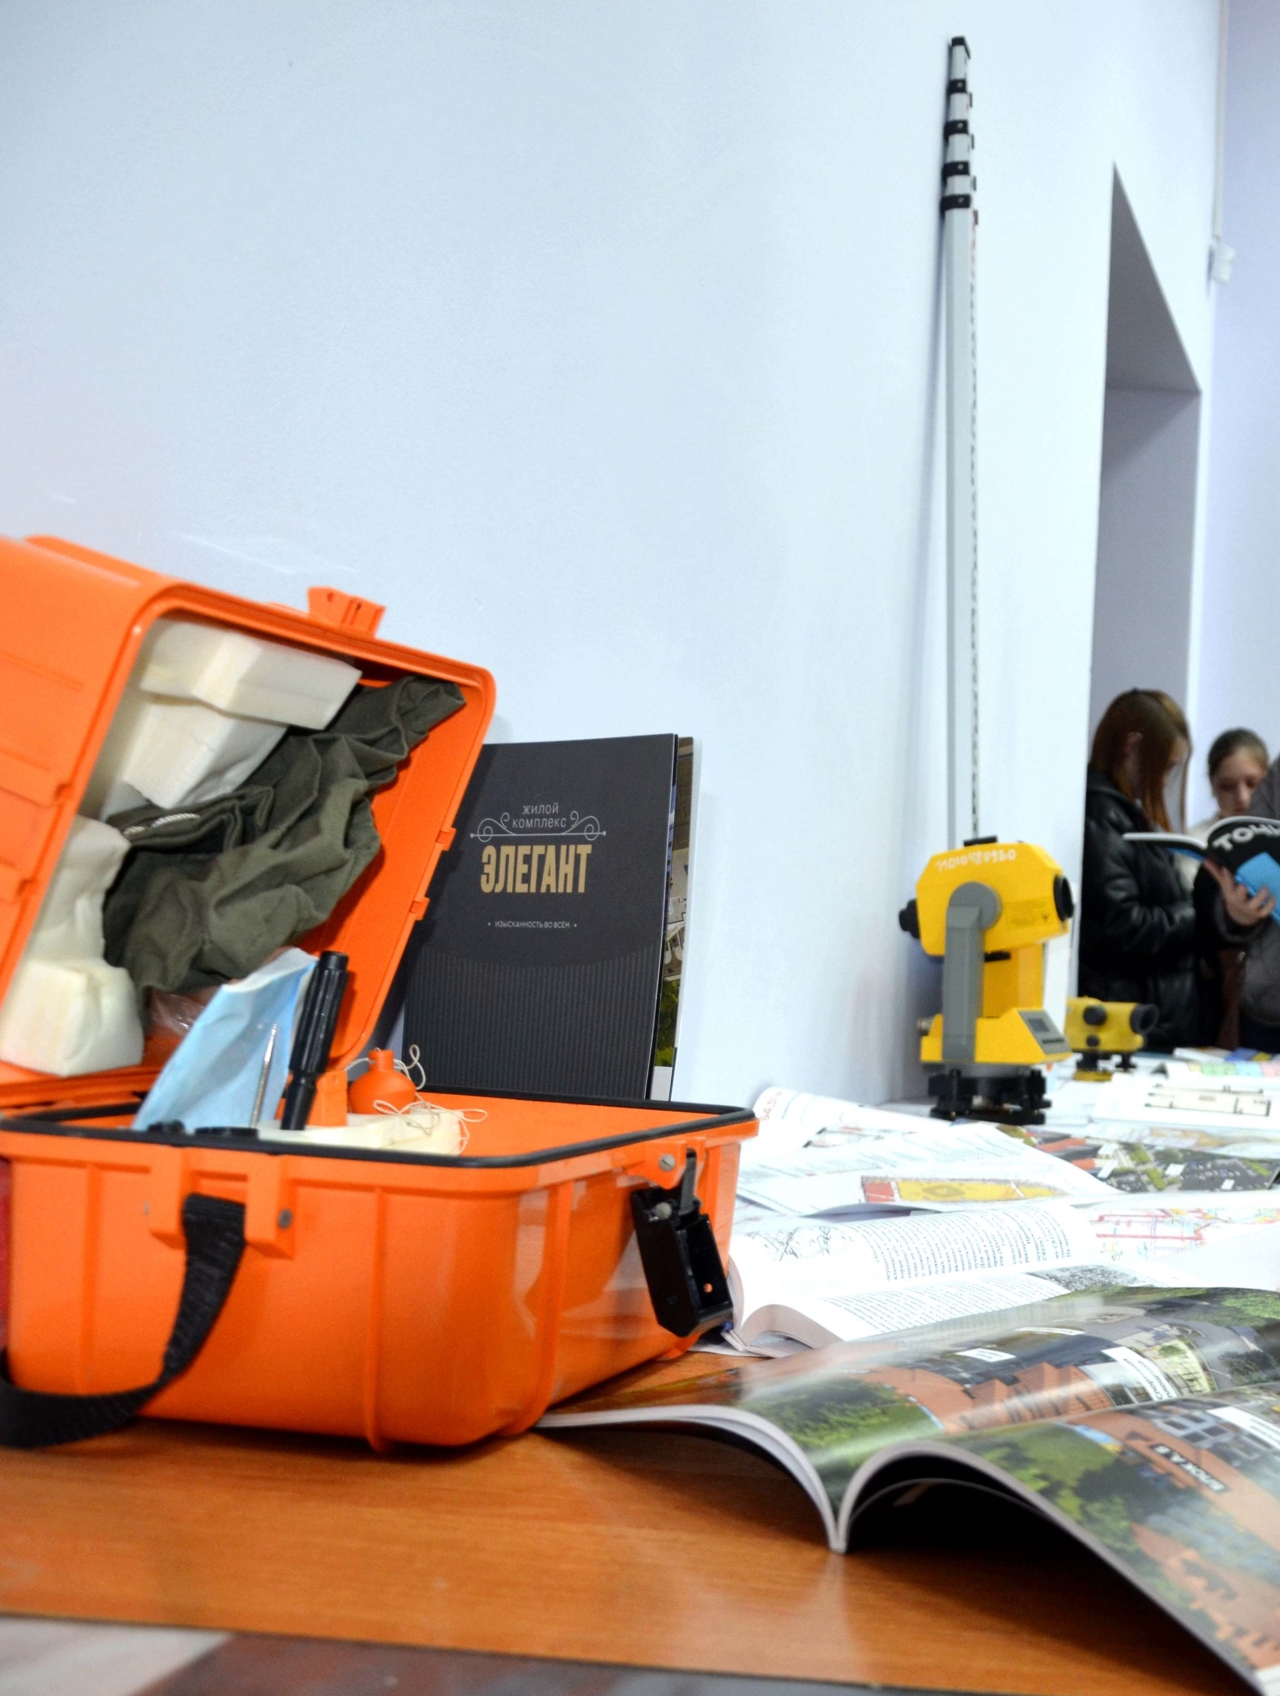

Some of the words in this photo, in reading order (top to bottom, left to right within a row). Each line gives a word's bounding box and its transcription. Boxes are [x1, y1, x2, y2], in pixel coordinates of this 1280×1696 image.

[522, 802, 559, 815] жилой
[512, 817, 567, 829] комплекс
[480, 844, 592, 894] ЭЛЕГАНТ
[494, 920, 543, 929] ИЗЫСКАННОСТЬ
[544, 921, 552, 929] ВО
